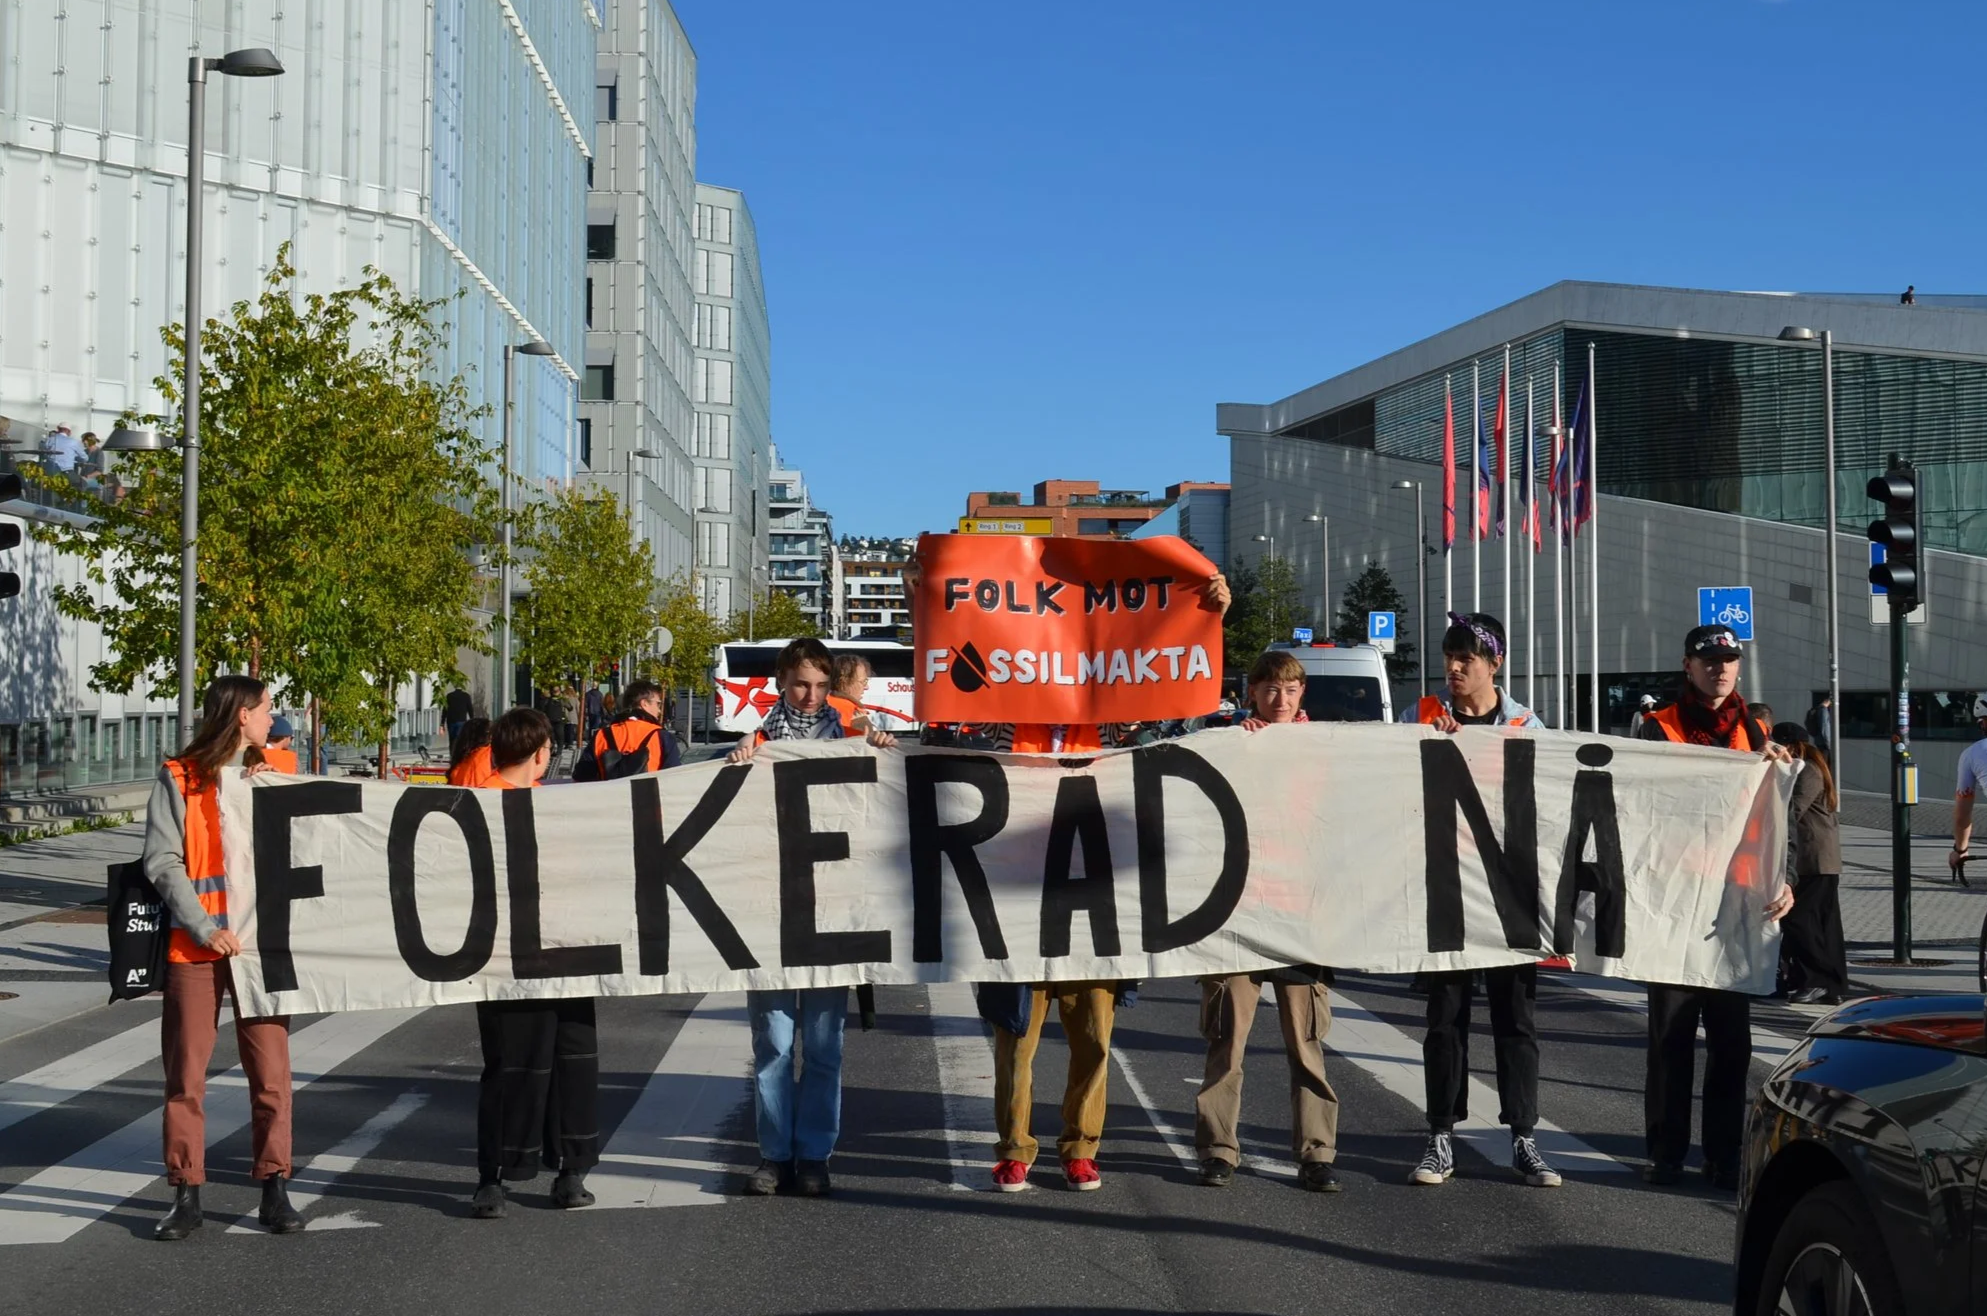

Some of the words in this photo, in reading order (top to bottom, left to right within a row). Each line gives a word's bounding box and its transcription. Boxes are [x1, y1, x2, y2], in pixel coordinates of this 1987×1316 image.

[944, 577, 1067, 616] FOLK
[1083, 576, 1177, 615] MOT
[1295, 630, 1312, 639] Taxi
[1375, 615, 1388, 636] P
[252, 743, 1250, 992] FOLKERÅD
[1420, 739, 1627, 958] NÅ
